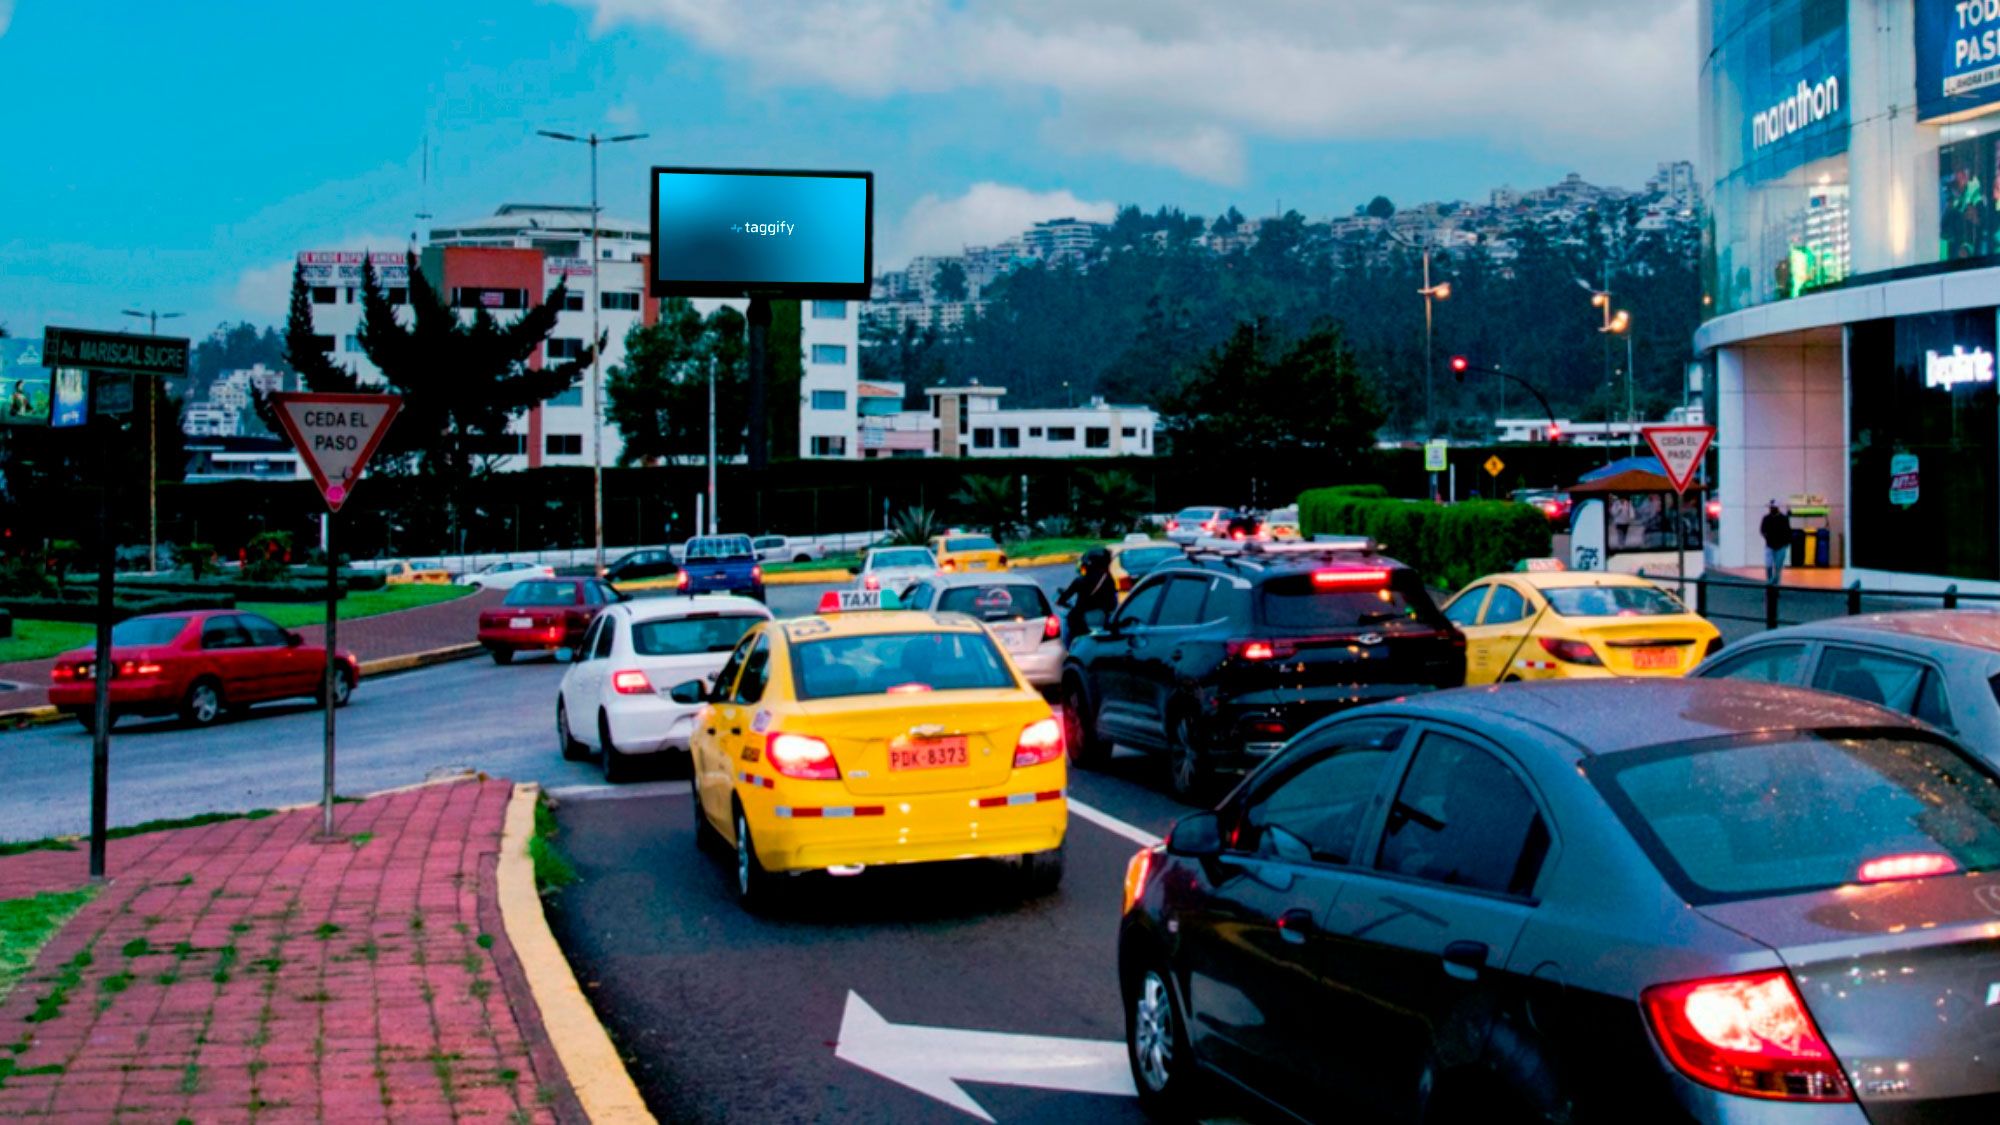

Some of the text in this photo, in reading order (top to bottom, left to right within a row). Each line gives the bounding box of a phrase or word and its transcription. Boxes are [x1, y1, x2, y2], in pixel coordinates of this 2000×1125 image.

[1956, 0, 2000, 29] TOD
[1753, 75, 1839, 150] marathon
[745, 220, 795, 236] taggify
[80, 341, 142, 366] MARISCAL
[143, 345, 184, 368] SUCRE
[304, 411, 369, 427] CEDA EL
[315, 435, 358, 450] PASO
[1661, 436, 1698, 446] CEDA EL
[1667, 449, 1692, 459] PASO
[842, 591, 879, 607] TAXI
[890, 747, 966, 768] PDK-8373
